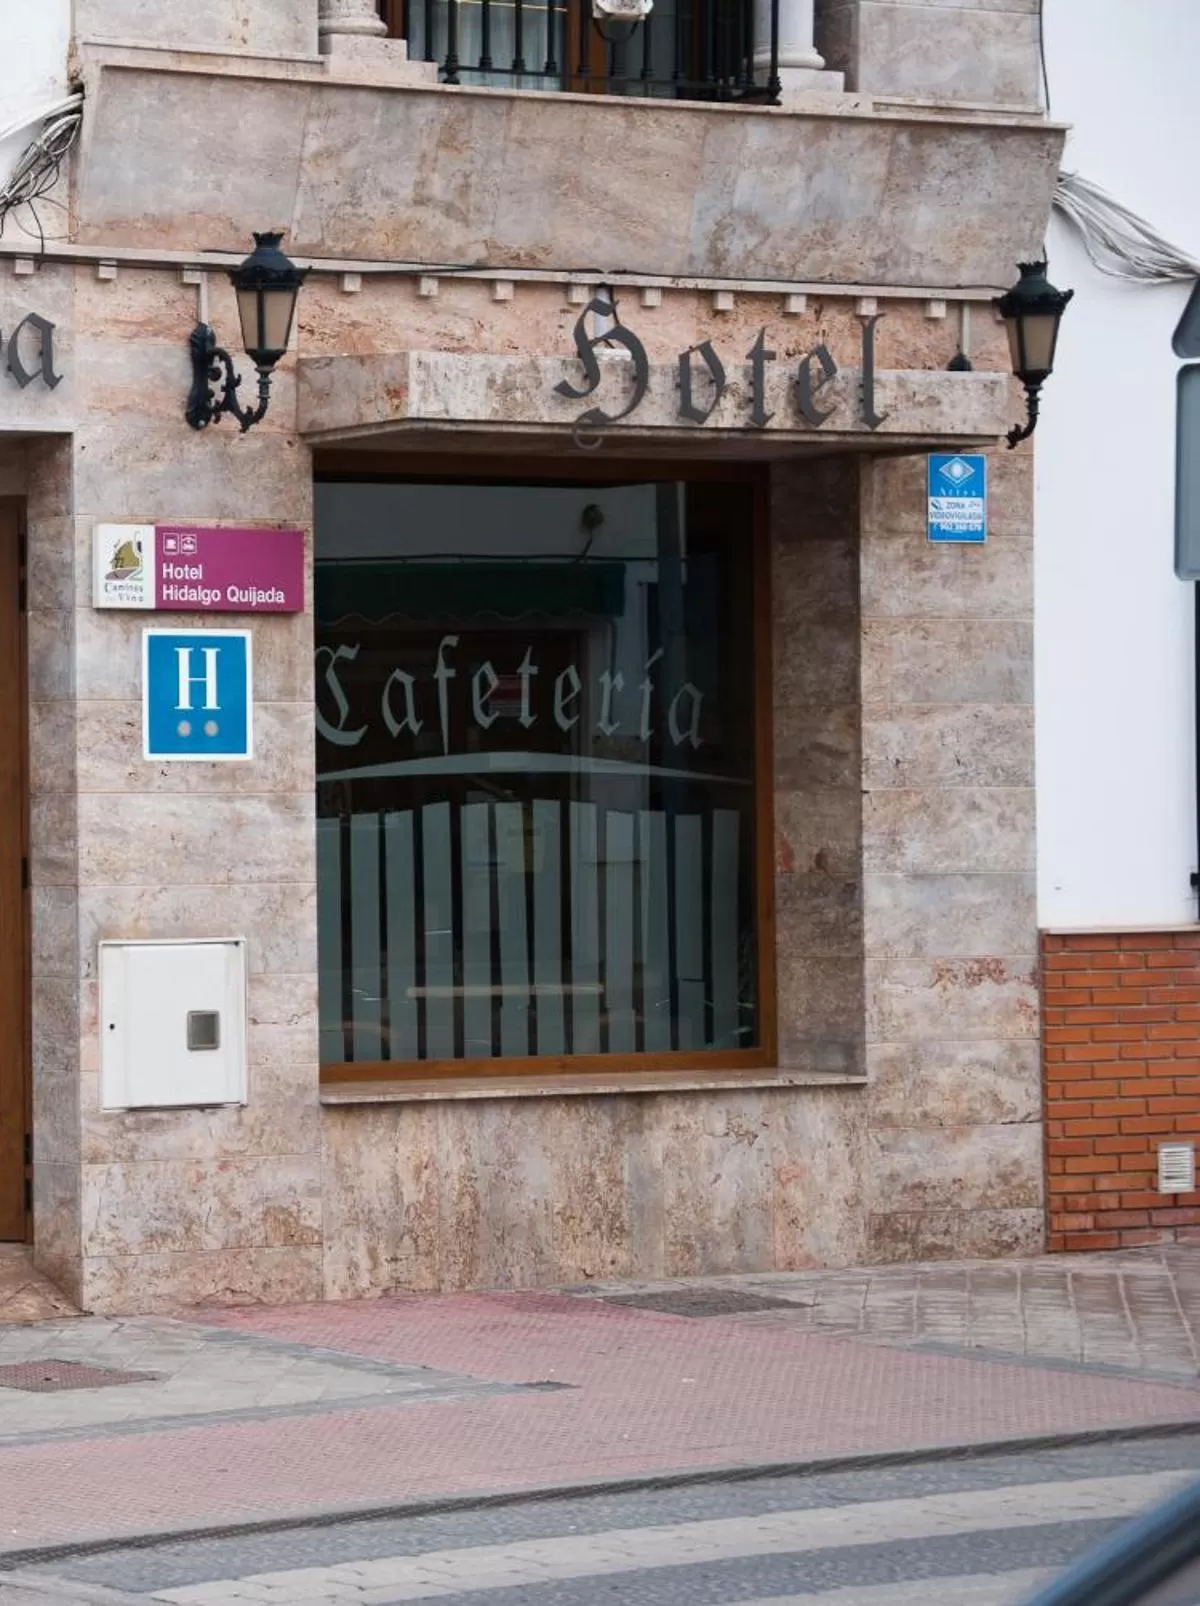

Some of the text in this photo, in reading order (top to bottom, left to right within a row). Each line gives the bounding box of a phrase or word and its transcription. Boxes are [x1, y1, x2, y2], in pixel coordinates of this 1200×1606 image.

[553, 297, 890, 449] Hotel
[162, 562, 203, 581] Hotel
[162, 584, 286, 607] Hidalgo Quijada
[173, 647, 222, 710] H
[314, 634, 705, 757] Cafetería
